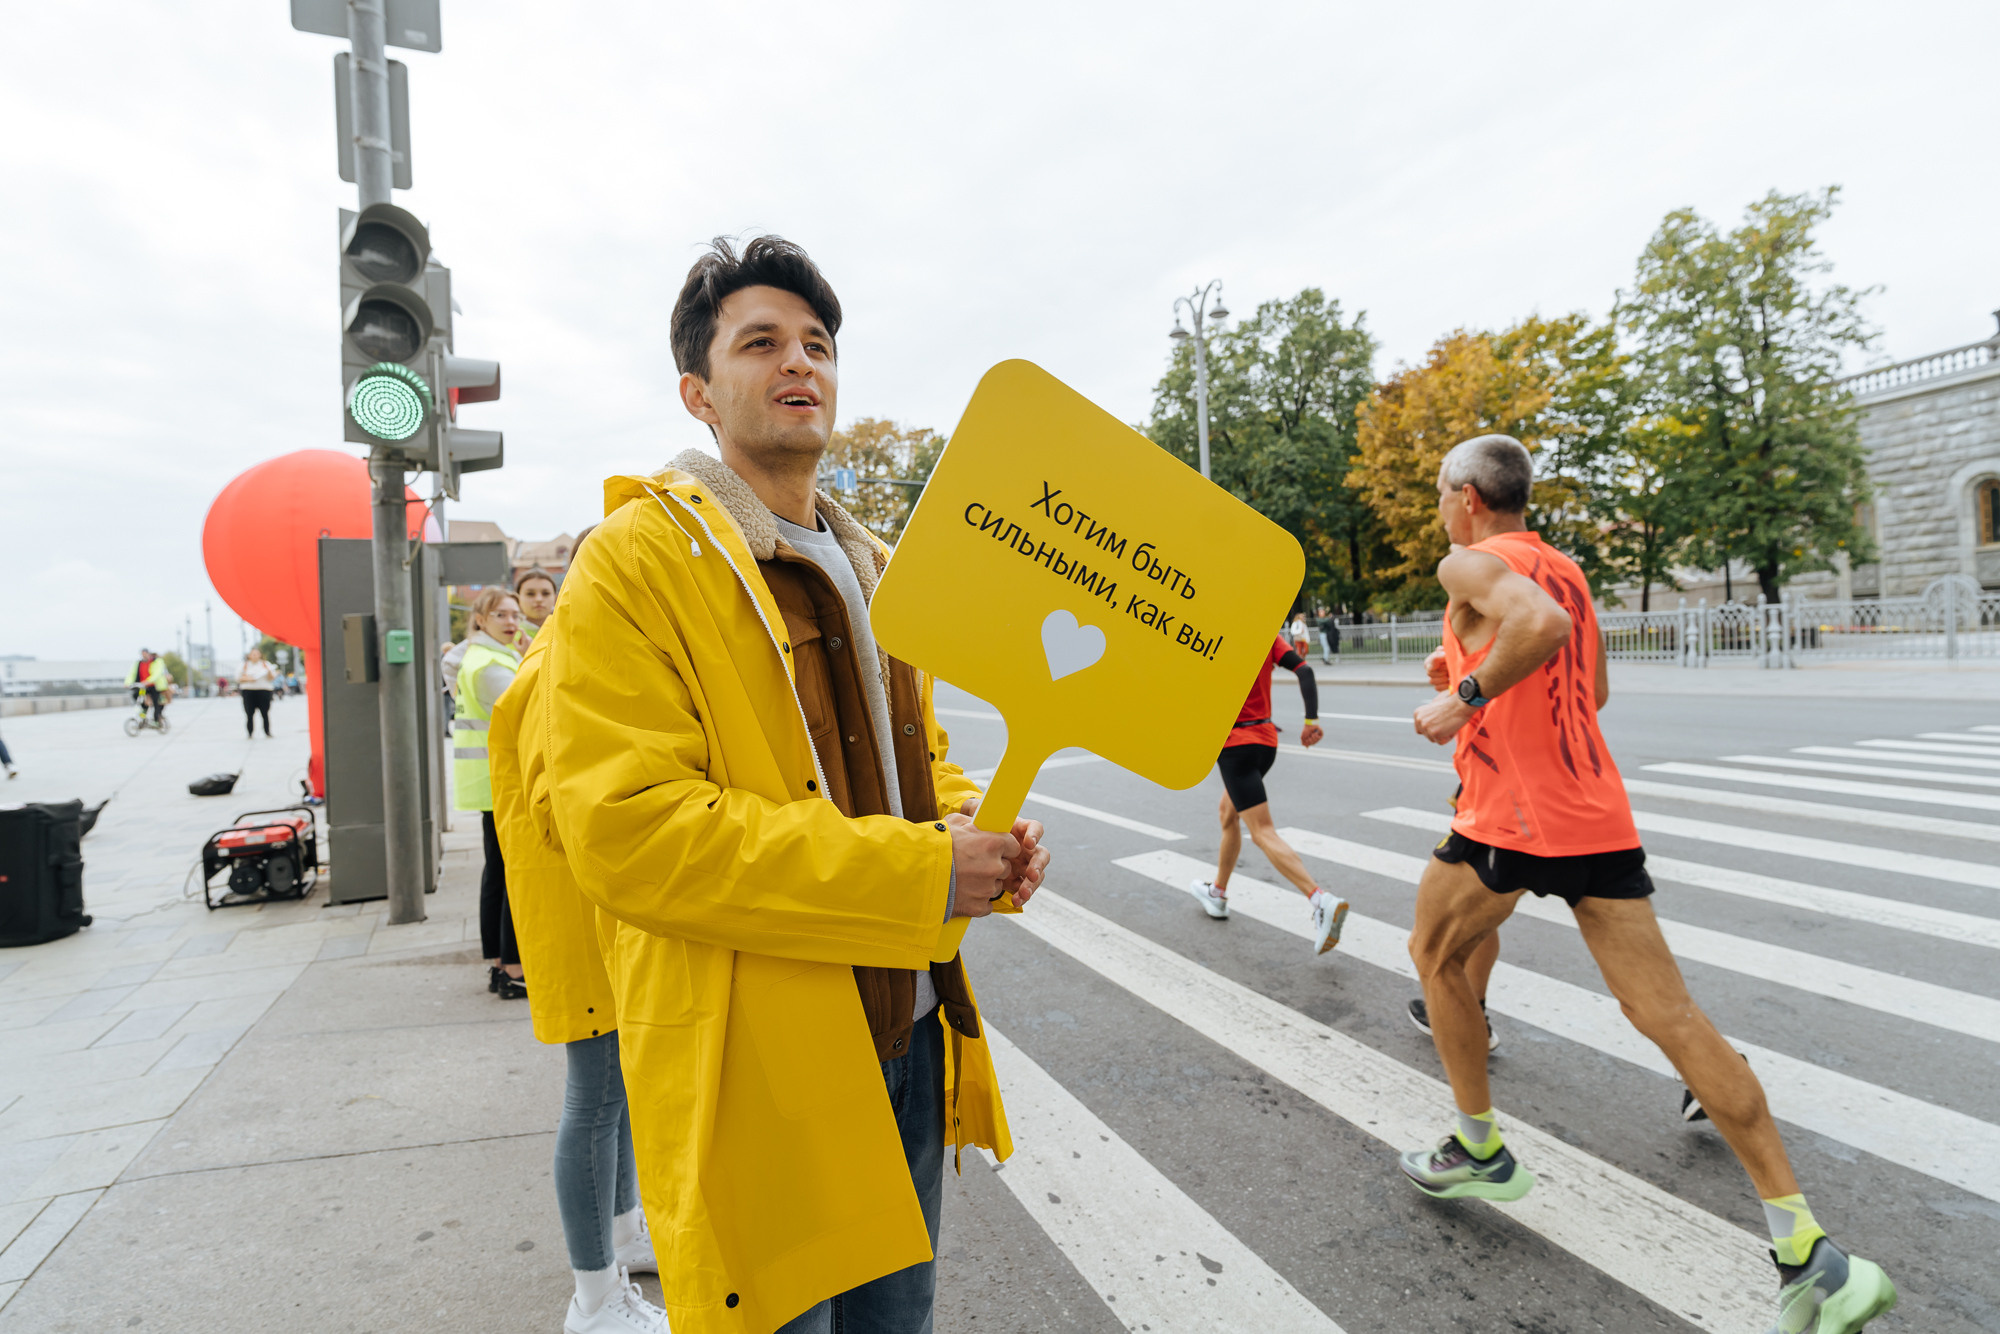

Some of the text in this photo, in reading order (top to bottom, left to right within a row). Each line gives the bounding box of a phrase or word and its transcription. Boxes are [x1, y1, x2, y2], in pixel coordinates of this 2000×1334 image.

[965, 503, 1224, 661] сильными, как вы!
[1030, 481, 1195, 599] Хотим быть
